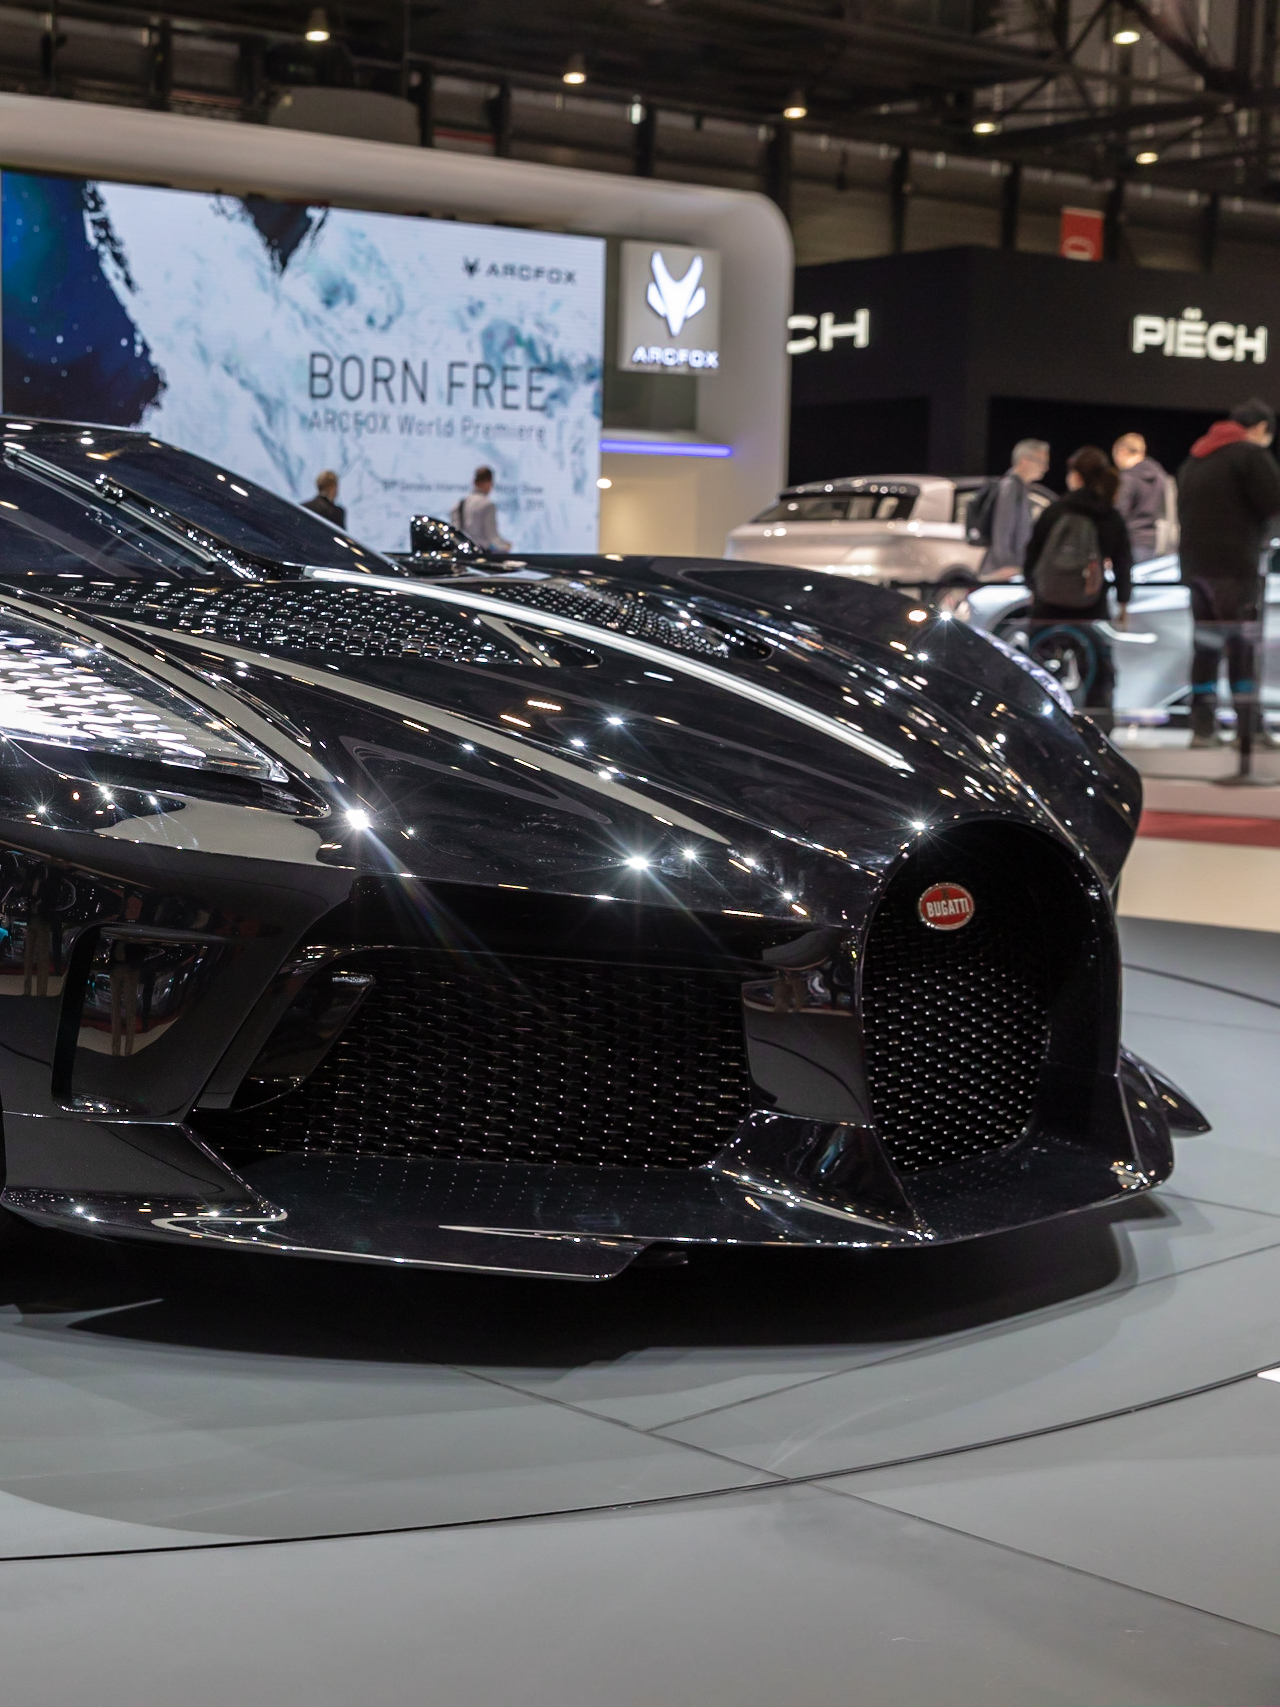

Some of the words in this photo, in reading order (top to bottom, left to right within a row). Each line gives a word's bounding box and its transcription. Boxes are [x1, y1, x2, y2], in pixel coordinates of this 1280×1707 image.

[486, 262, 577, 285] ARCFOX
[1132, 306, 1268, 364] PIËCH
[632, 345, 719, 369] ARCFOX
[308, 352, 428, 404] BORN
[447, 361, 548, 411] FREE
[307, 409, 391, 434] ARCFOX
[396, 414, 454, 438] World
[460, 416, 547, 443] Premiere
[926, 897, 970, 918] BUGATTI
